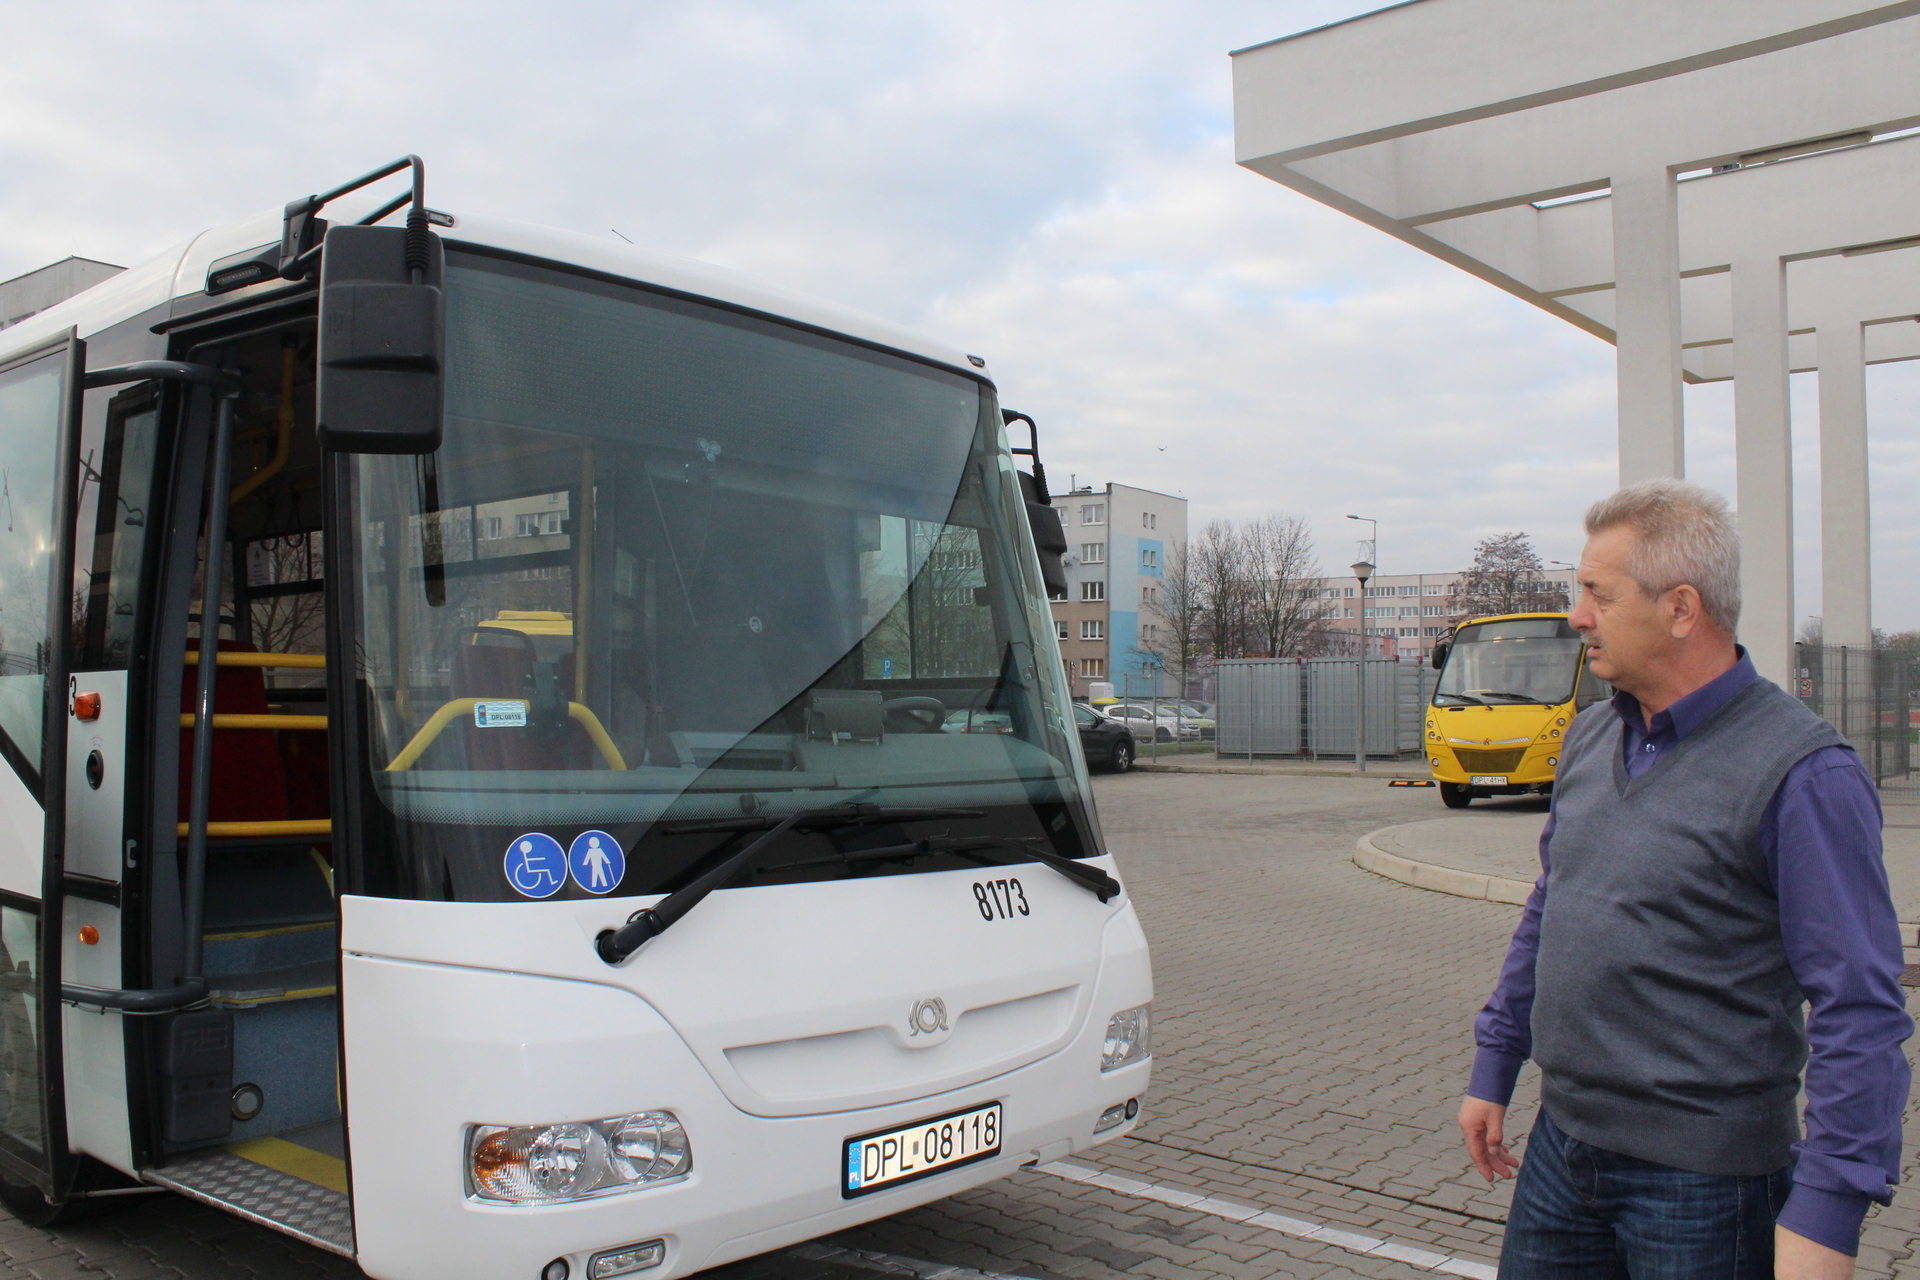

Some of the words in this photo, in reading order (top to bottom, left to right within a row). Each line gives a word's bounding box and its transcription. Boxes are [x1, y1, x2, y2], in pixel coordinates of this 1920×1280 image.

[884, 660, 890, 672] P
[972, 877, 1030, 922] 8173
[864, 1135, 914, 1182] DPL
[924, 1110, 996, 1164] 08118
[849, 1171, 860, 1183] PL
